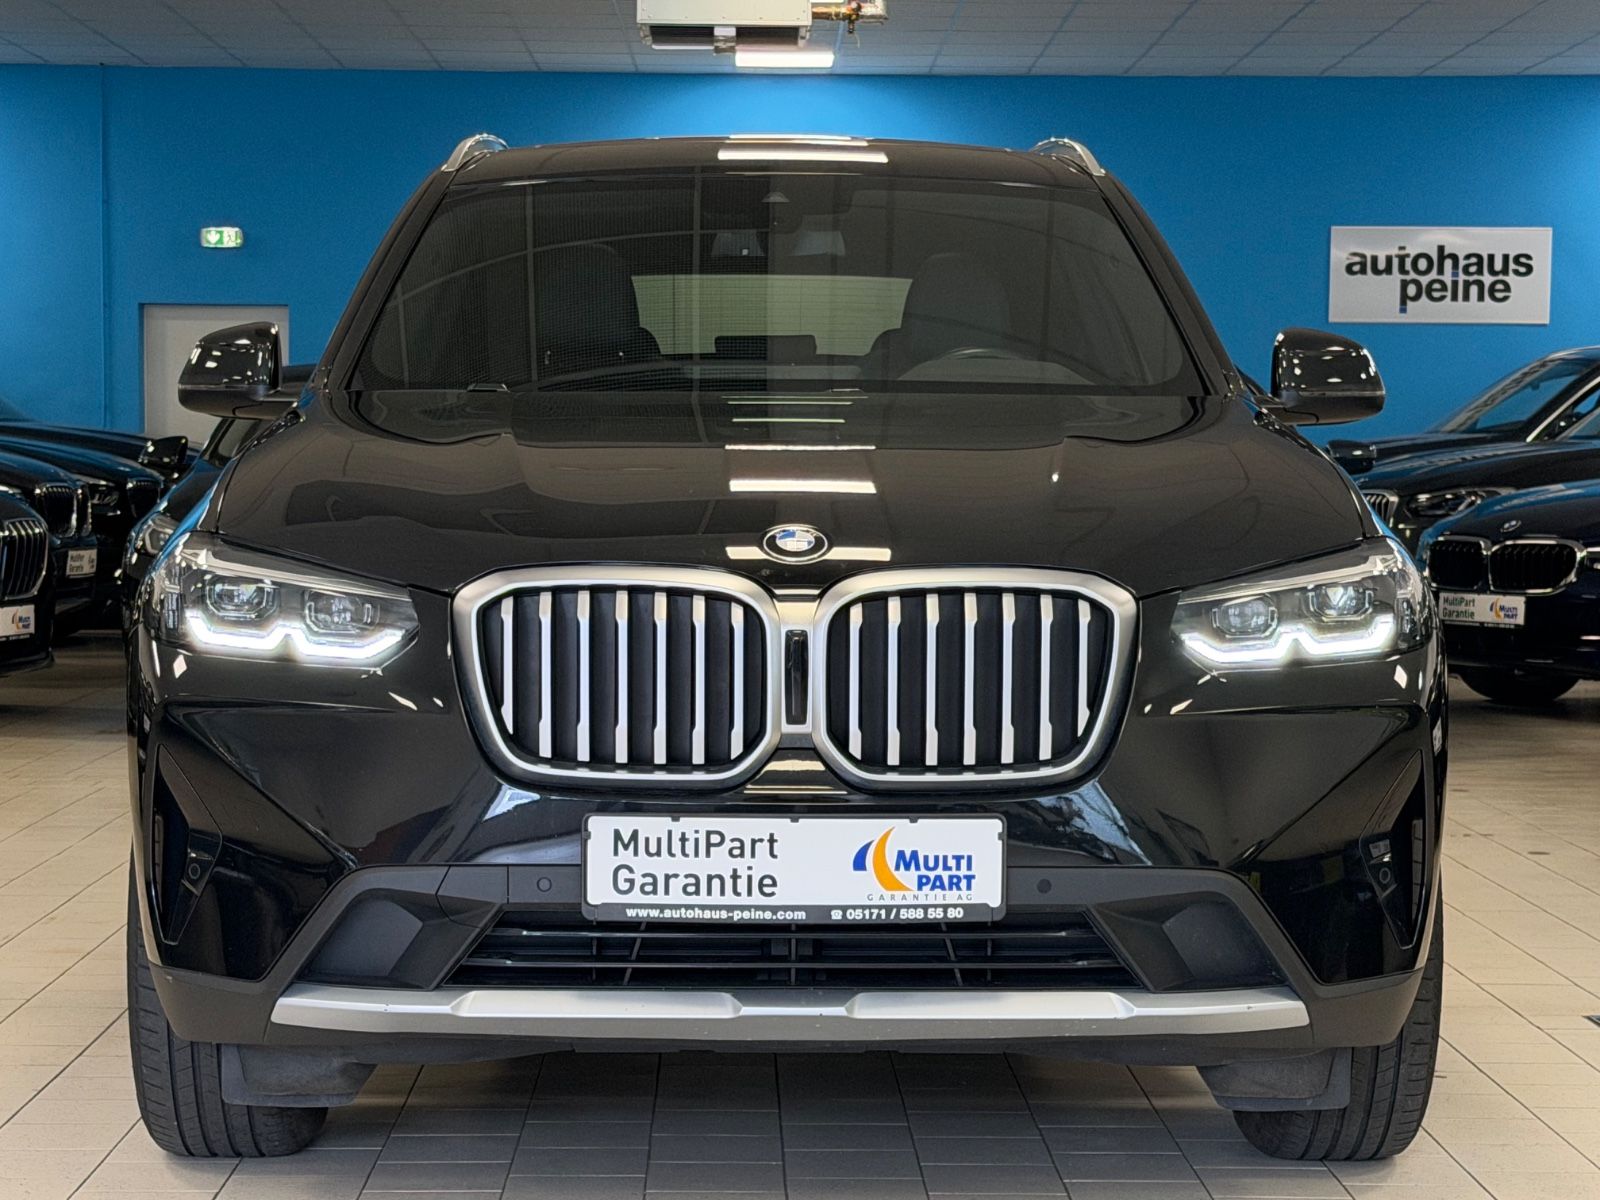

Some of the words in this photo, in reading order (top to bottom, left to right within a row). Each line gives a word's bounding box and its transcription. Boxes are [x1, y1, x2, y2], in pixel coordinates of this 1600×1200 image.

[1345, 245, 1534, 277] autohaus
[1399, 272, 1512, 314] peine
[612, 828, 779, 860] MultiPart
[894, 849, 973, 872] MULTI
[612, 863, 778, 898] Garantie
[916, 874, 976, 892] PART
[866, 893, 948, 902] GARANTIE
[956, 893, 973, 901] AG
[625, 906, 806, 921] www.autohaus-peine.com
[846, 908, 886, 920] 05171
[899, 907, 925, 919] 588
[927, 907, 944, 919] 55
[946, 907, 964, 919] 80
